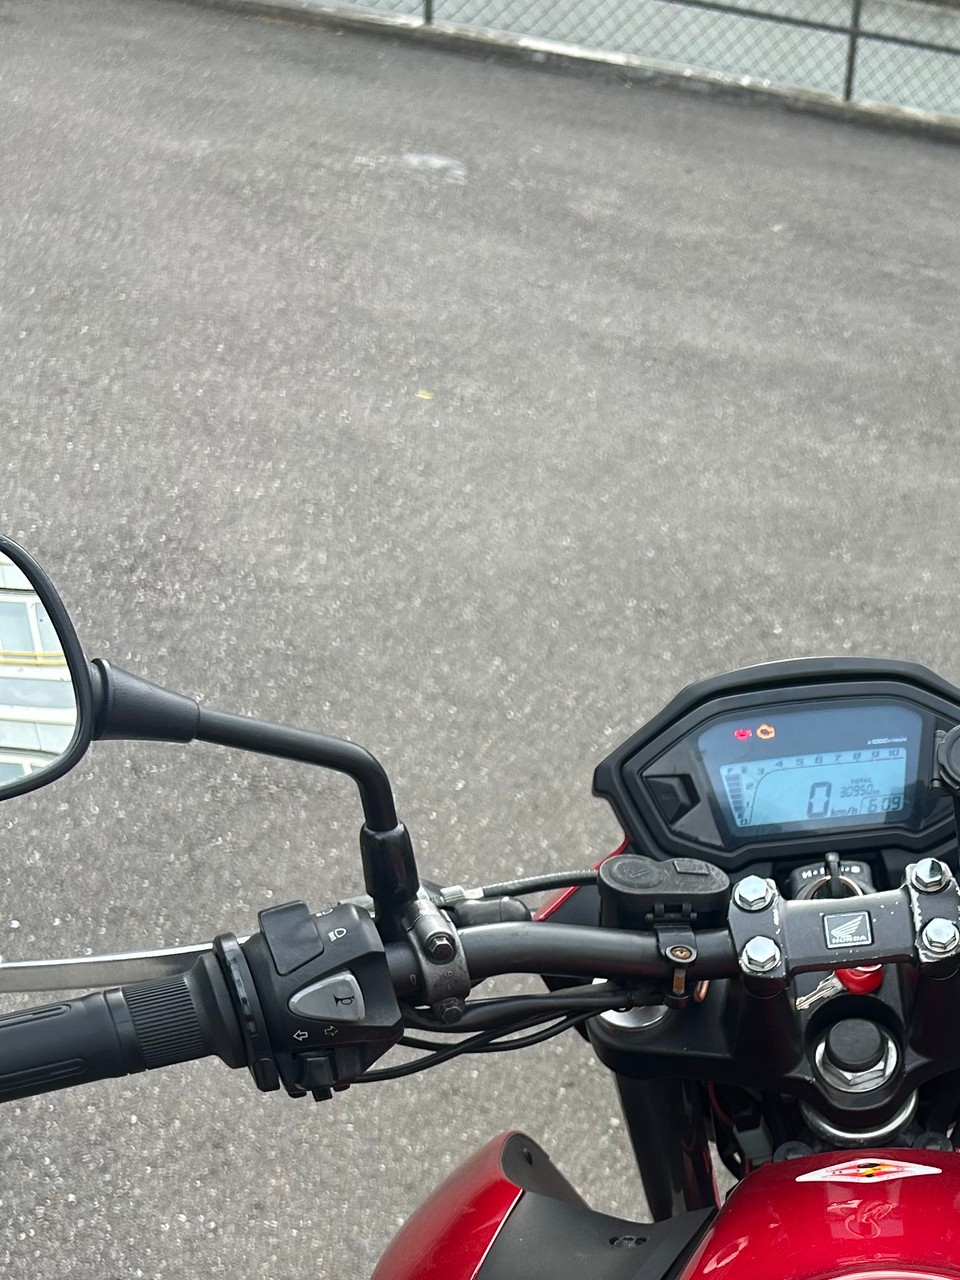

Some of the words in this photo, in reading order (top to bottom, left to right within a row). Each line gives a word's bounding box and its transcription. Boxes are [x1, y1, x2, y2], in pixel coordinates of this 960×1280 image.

[775, 760, 783, 768] 4
[815, 756, 823, 764] 6
[834, 754, 842, 762] 7
[853, 752, 861, 760] 8
[889, 749, 900, 757] 10
[807, 781, 832, 819] 0
[830, 807, 858, 817] km/h
[839, 784, 873, 799] 30950
[832, 935, 867, 943] HONDA
